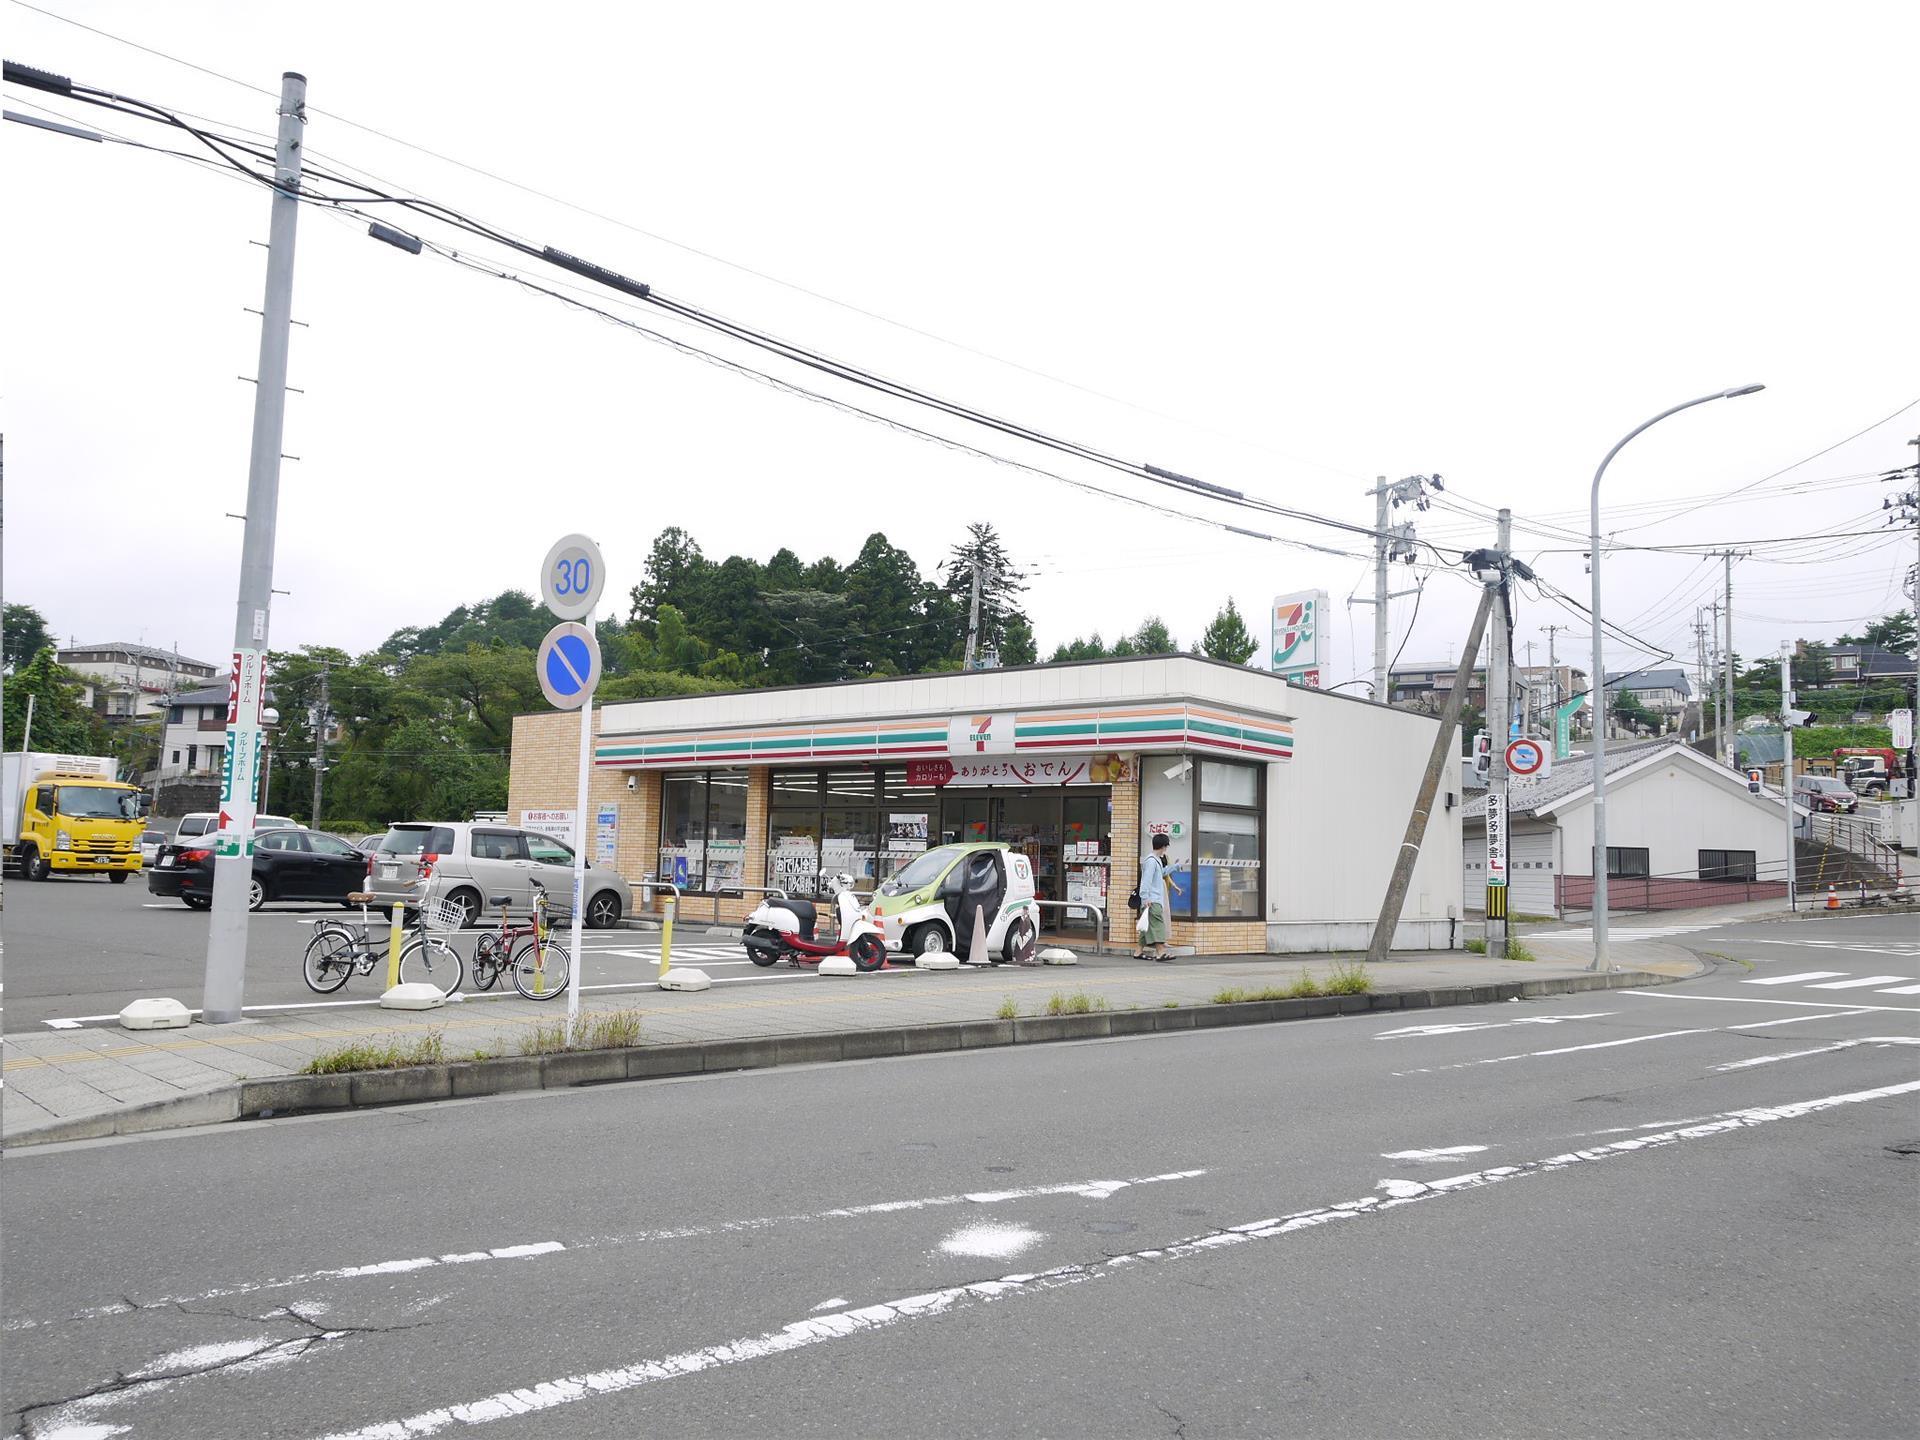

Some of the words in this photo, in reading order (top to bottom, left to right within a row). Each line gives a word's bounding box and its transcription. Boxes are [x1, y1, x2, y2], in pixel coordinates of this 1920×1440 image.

[555, 558, 590, 596] 30
[961, 762, 1008, 777] ありがとう
[1024, 761, 1071, 777] おでん
[1149, 823, 1169, 834] たばこ
[1487, 794, 1499, 859] 多夢多夢舎
